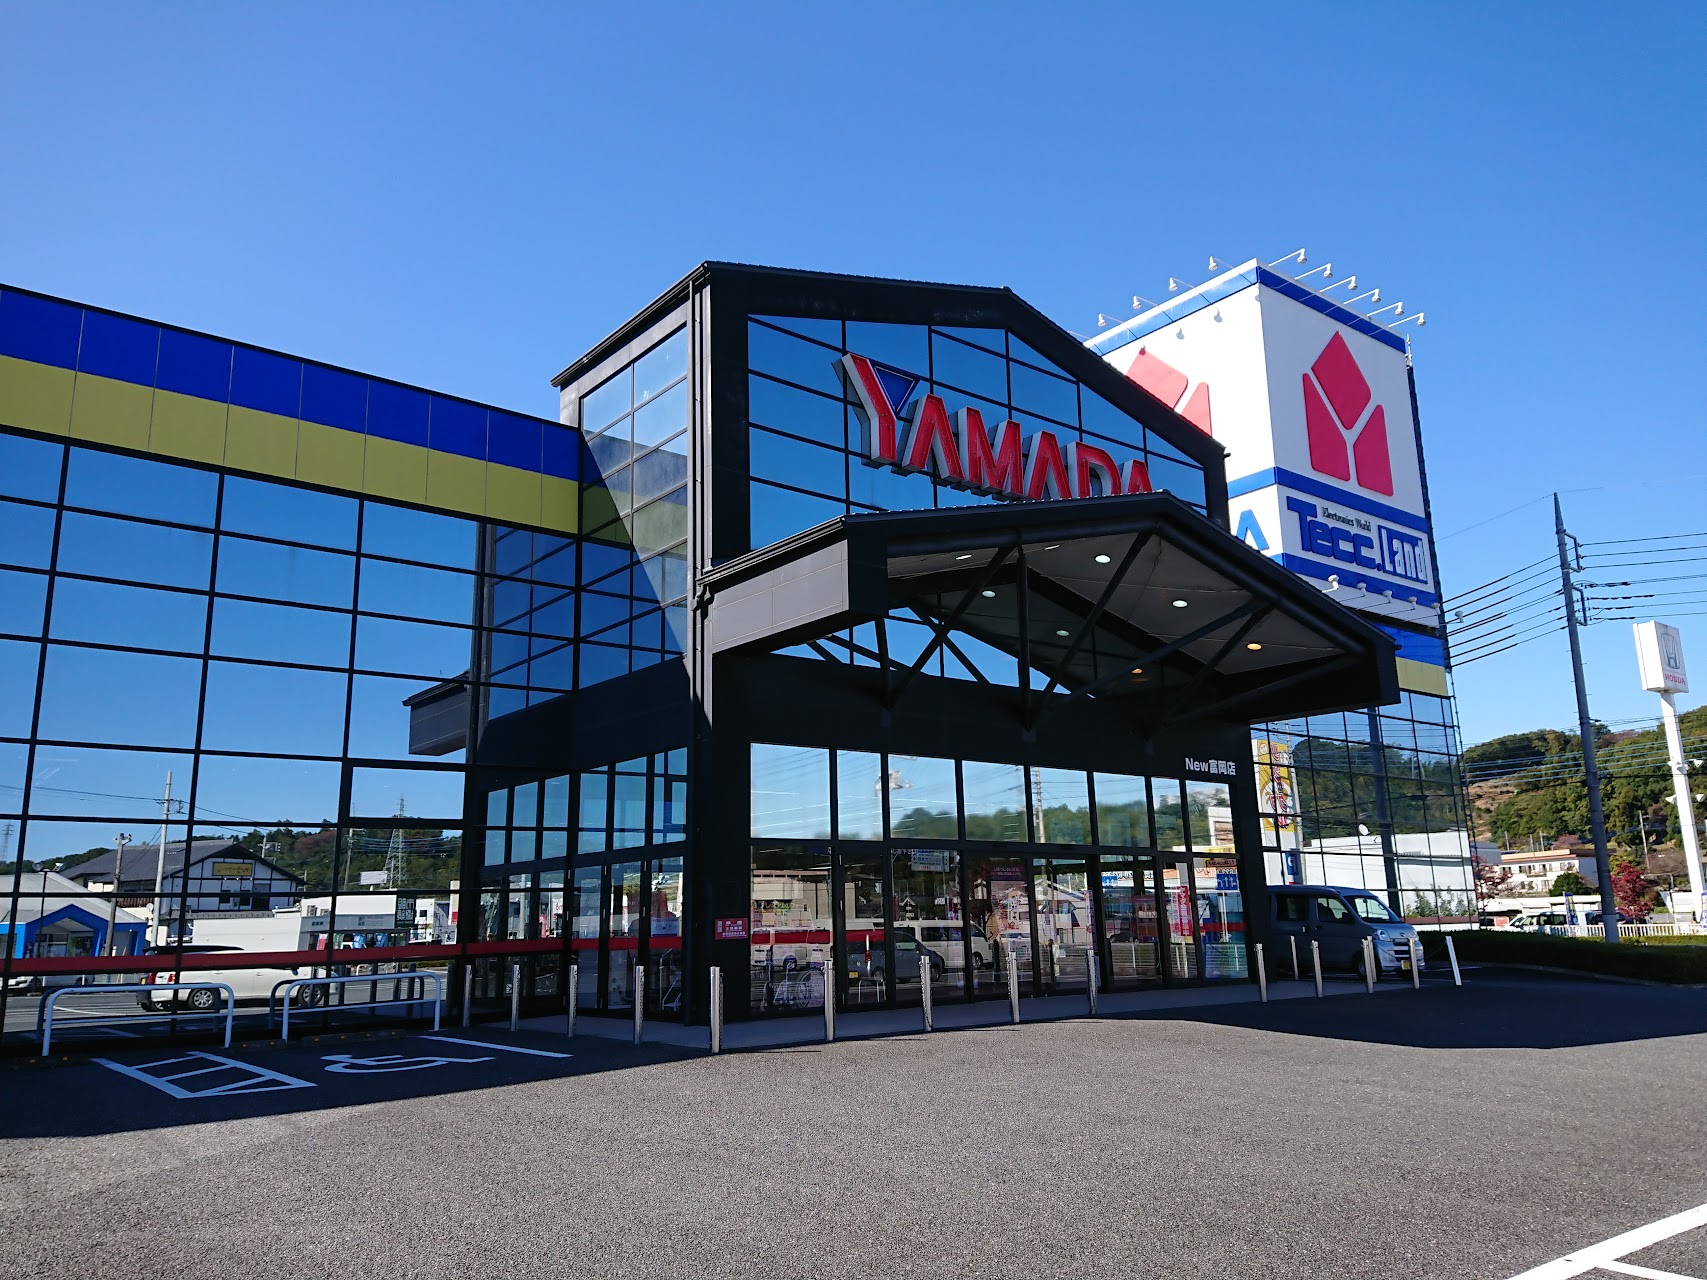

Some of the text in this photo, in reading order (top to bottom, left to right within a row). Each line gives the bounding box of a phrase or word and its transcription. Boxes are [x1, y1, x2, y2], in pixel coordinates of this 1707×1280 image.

[836, 352, 1153, 501] YAMADA
[1321, 507, 1372, 531] Electronics World
[1664, 672, 1686, 685] HONDA
